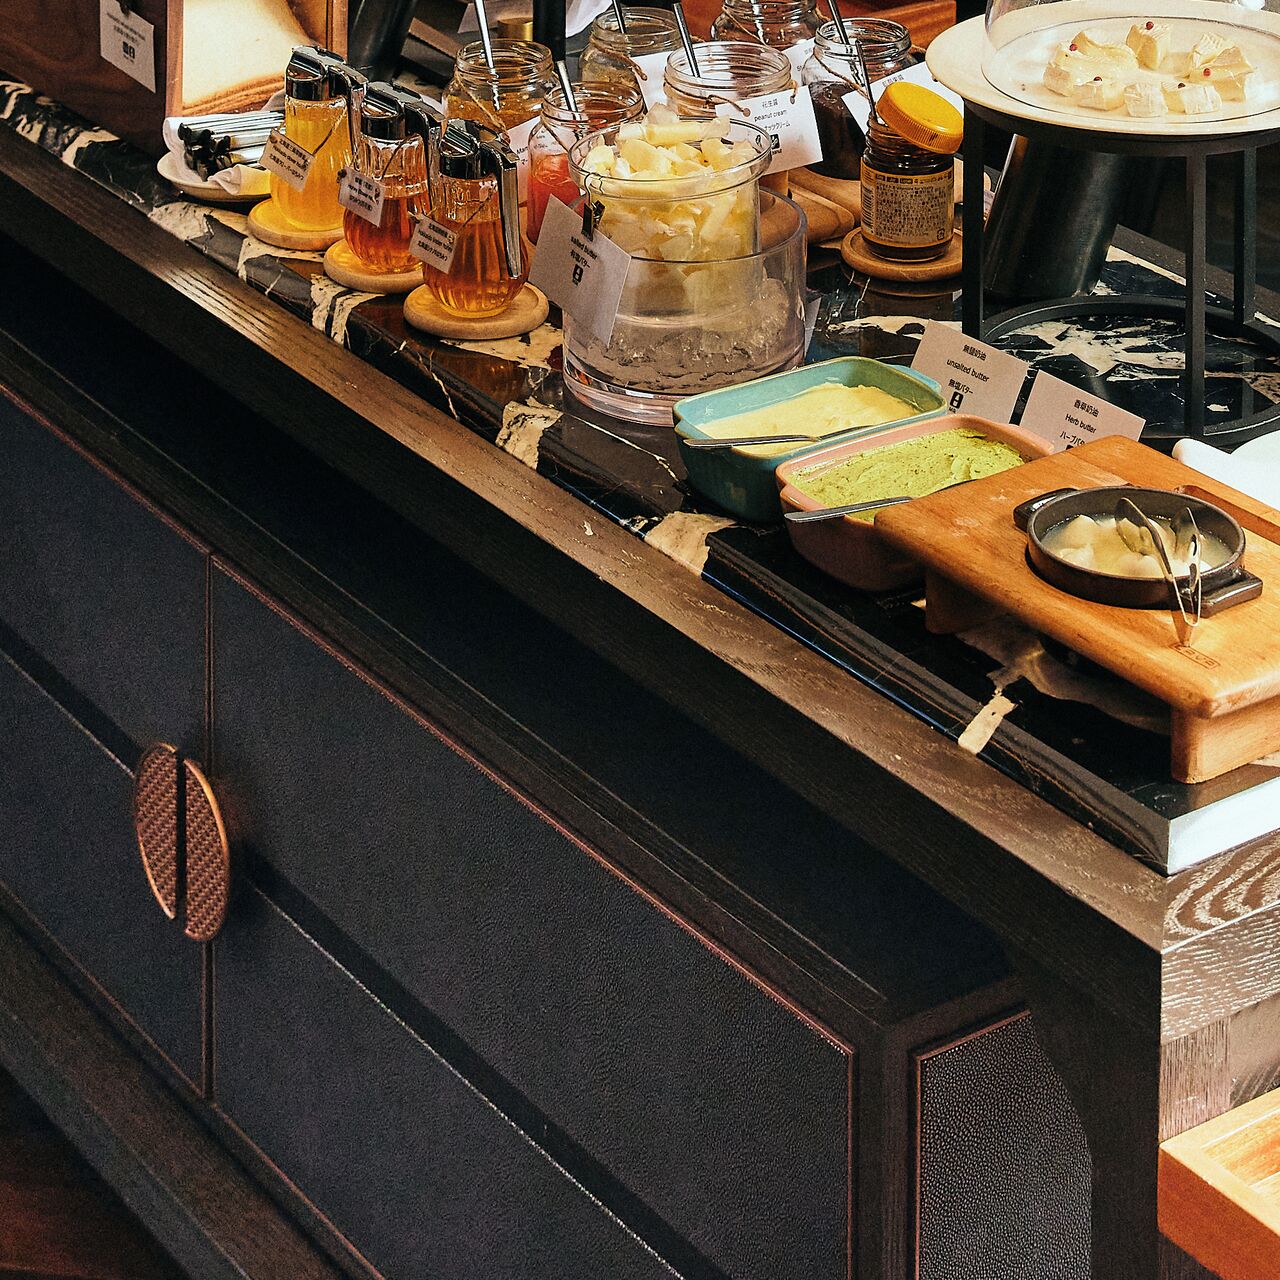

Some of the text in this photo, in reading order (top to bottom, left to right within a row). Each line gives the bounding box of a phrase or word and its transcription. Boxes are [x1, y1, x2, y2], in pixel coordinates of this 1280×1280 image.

[754, 112, 773, 122] peanut
[947, 359, 990, 382] unsalted butter
[1074, 399, 1099, 417] 香草奶油
[1065, 413, 1096, 433] Herb butter
[1060, 431, 1085, 446] ハーブバタ
